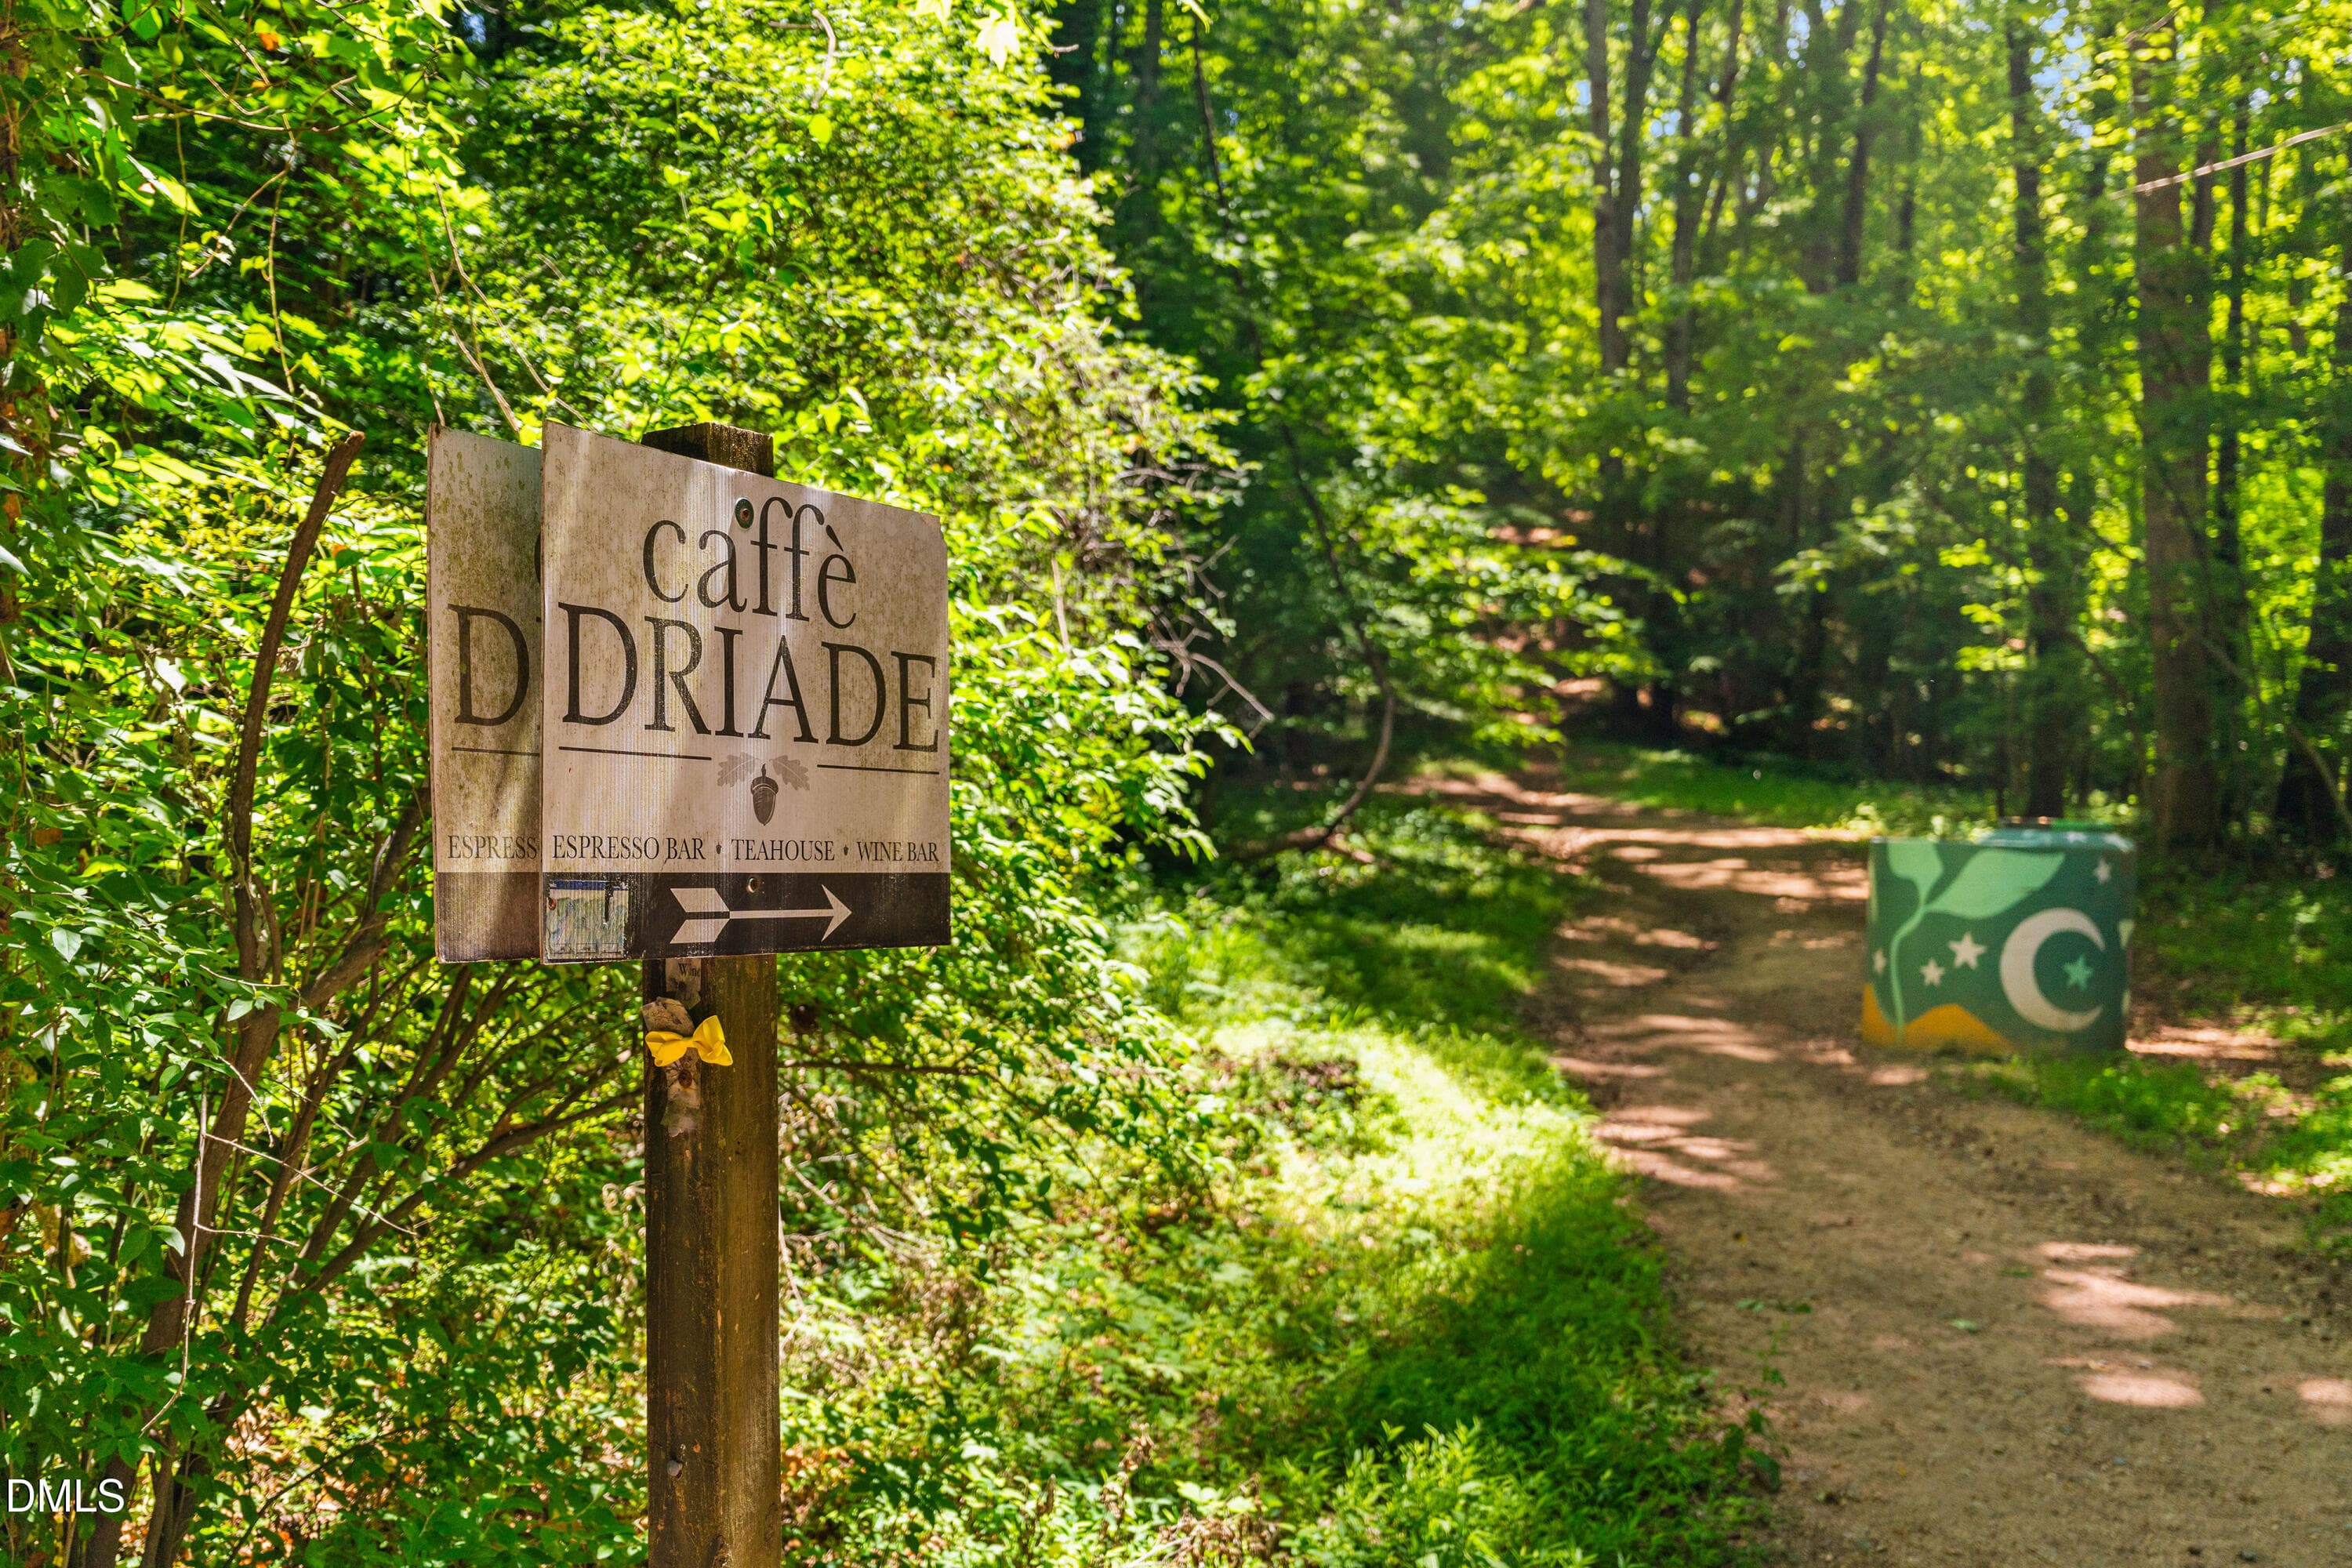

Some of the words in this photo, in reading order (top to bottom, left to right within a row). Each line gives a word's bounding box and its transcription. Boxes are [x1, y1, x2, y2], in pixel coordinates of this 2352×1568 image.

[642, 496, 857, 630] caffè
[557, 601, 939, 753] DRIADE
[552, 834, 660, 860] ESPRESSO
[666, 837, 707, 860] BAR
[731, 838, 836, 862] TEAHOUSE
[855, 840, 902, 862] WINE
[907, 841, 940, 862] BAR
